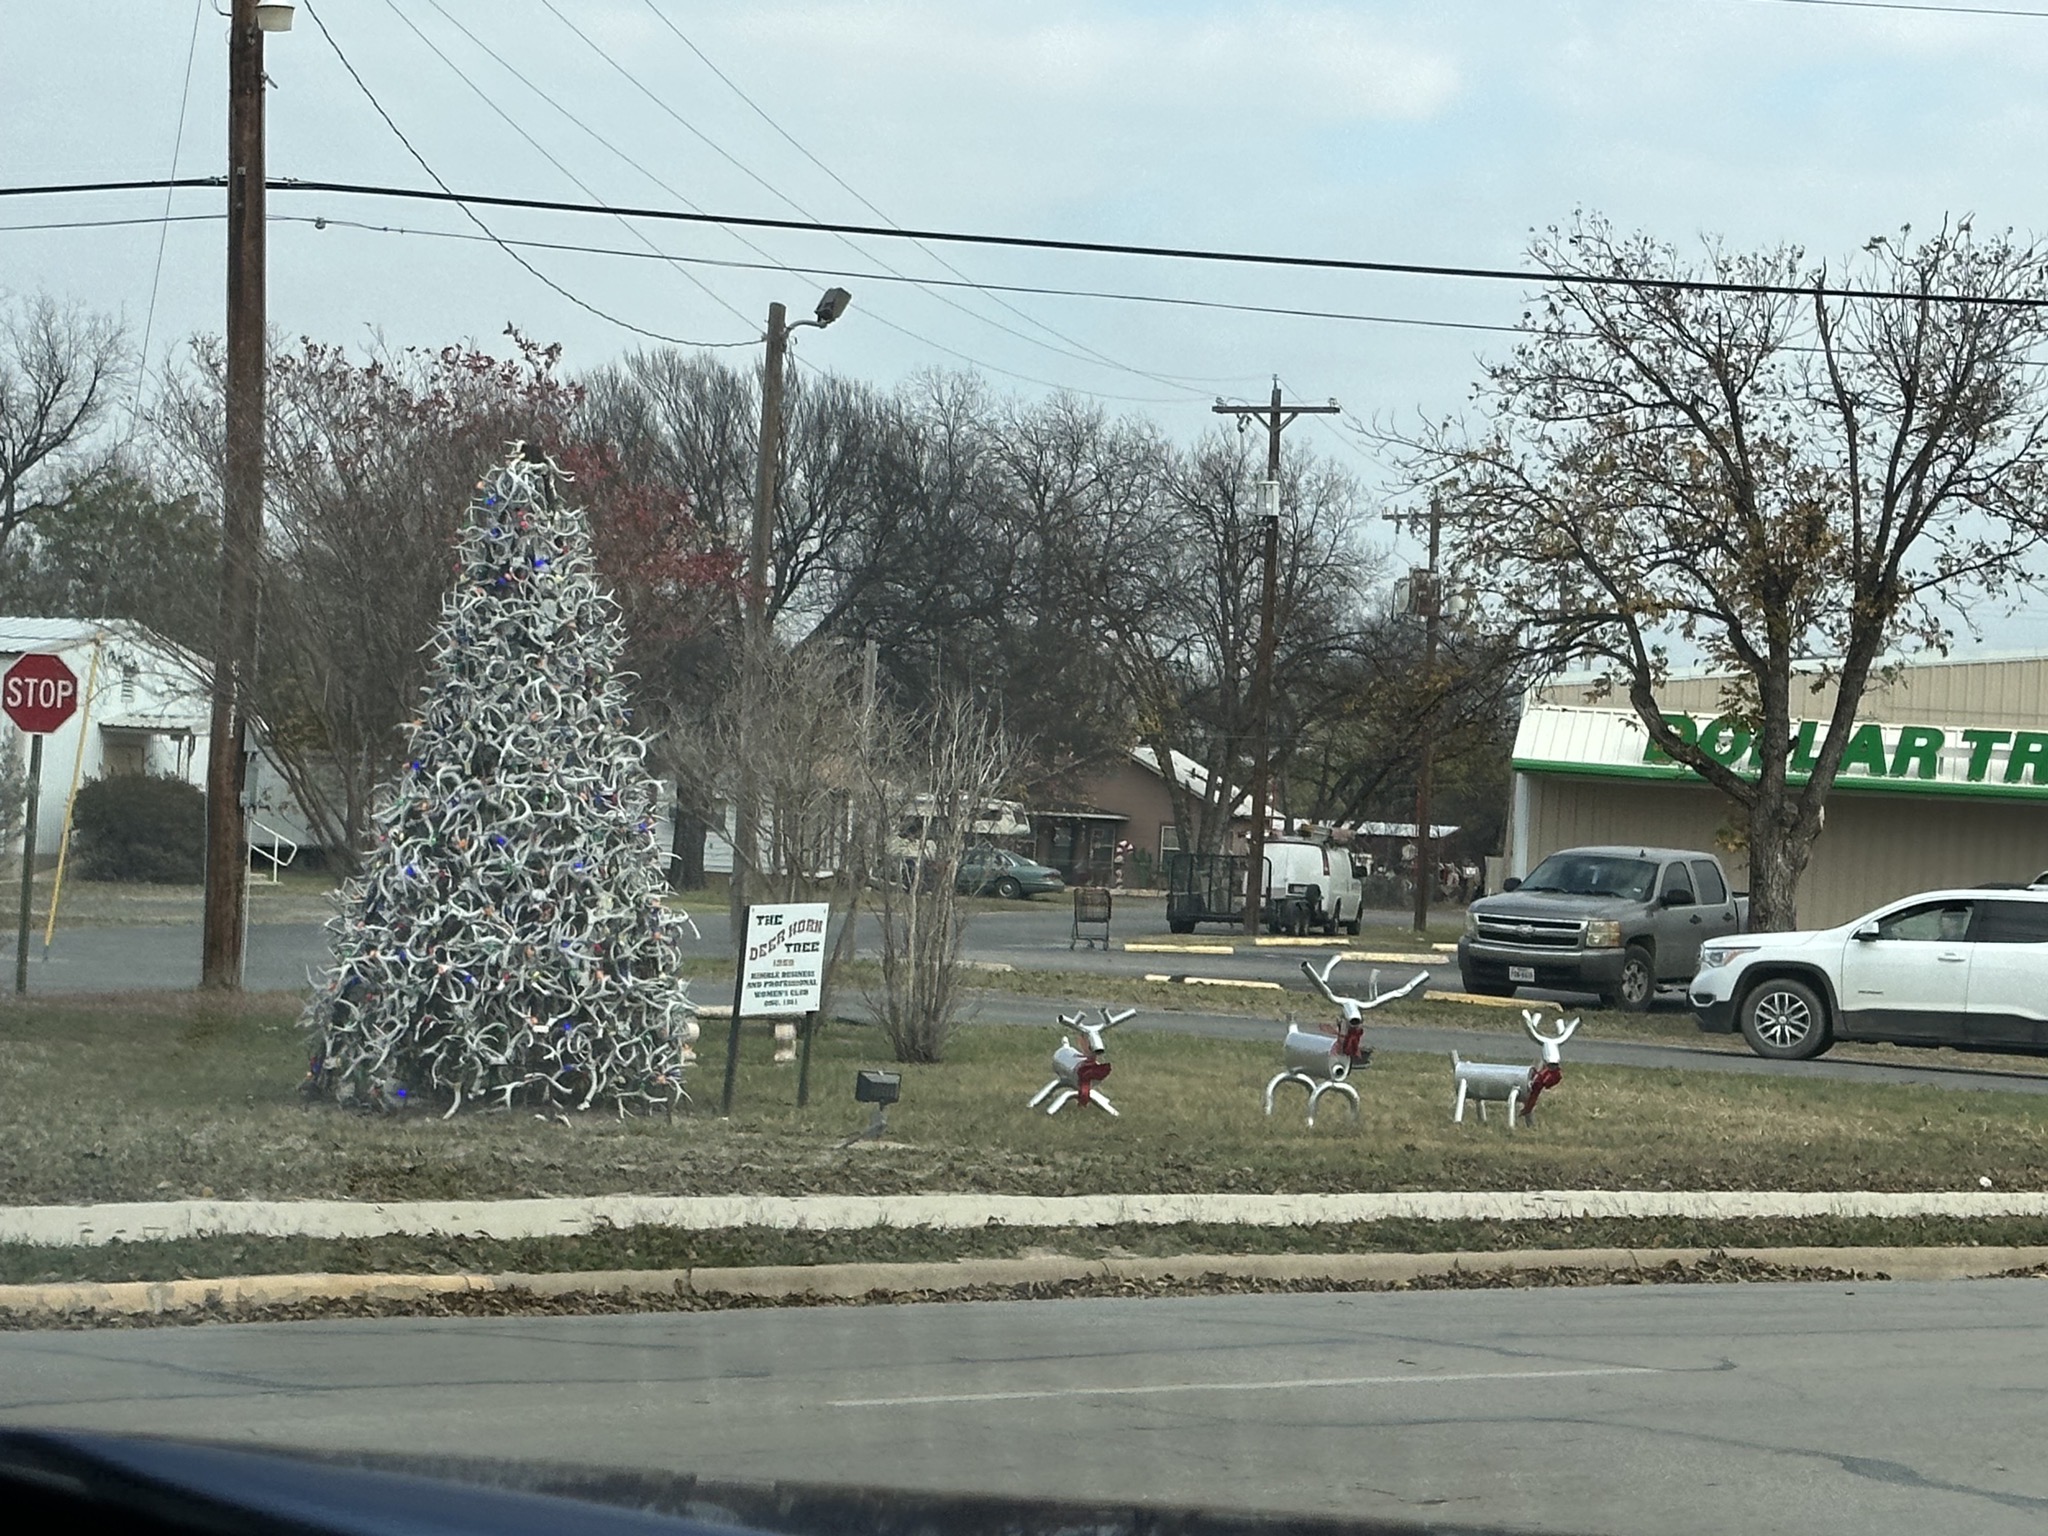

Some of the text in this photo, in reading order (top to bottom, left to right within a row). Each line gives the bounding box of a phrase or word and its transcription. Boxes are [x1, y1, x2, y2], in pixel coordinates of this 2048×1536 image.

[6, 676, 73, 709] STOP
[756, 914, 783, 926] THE
[749, 918, 823, 961] DEER HORN
[784, 941, 820, 953] TREE
[781, 970, 815, 978] BUSINESS
[747, 979, 817, 989] AND PROFESSIONAL
[754, 989, 788, 998] WOMEN'S
